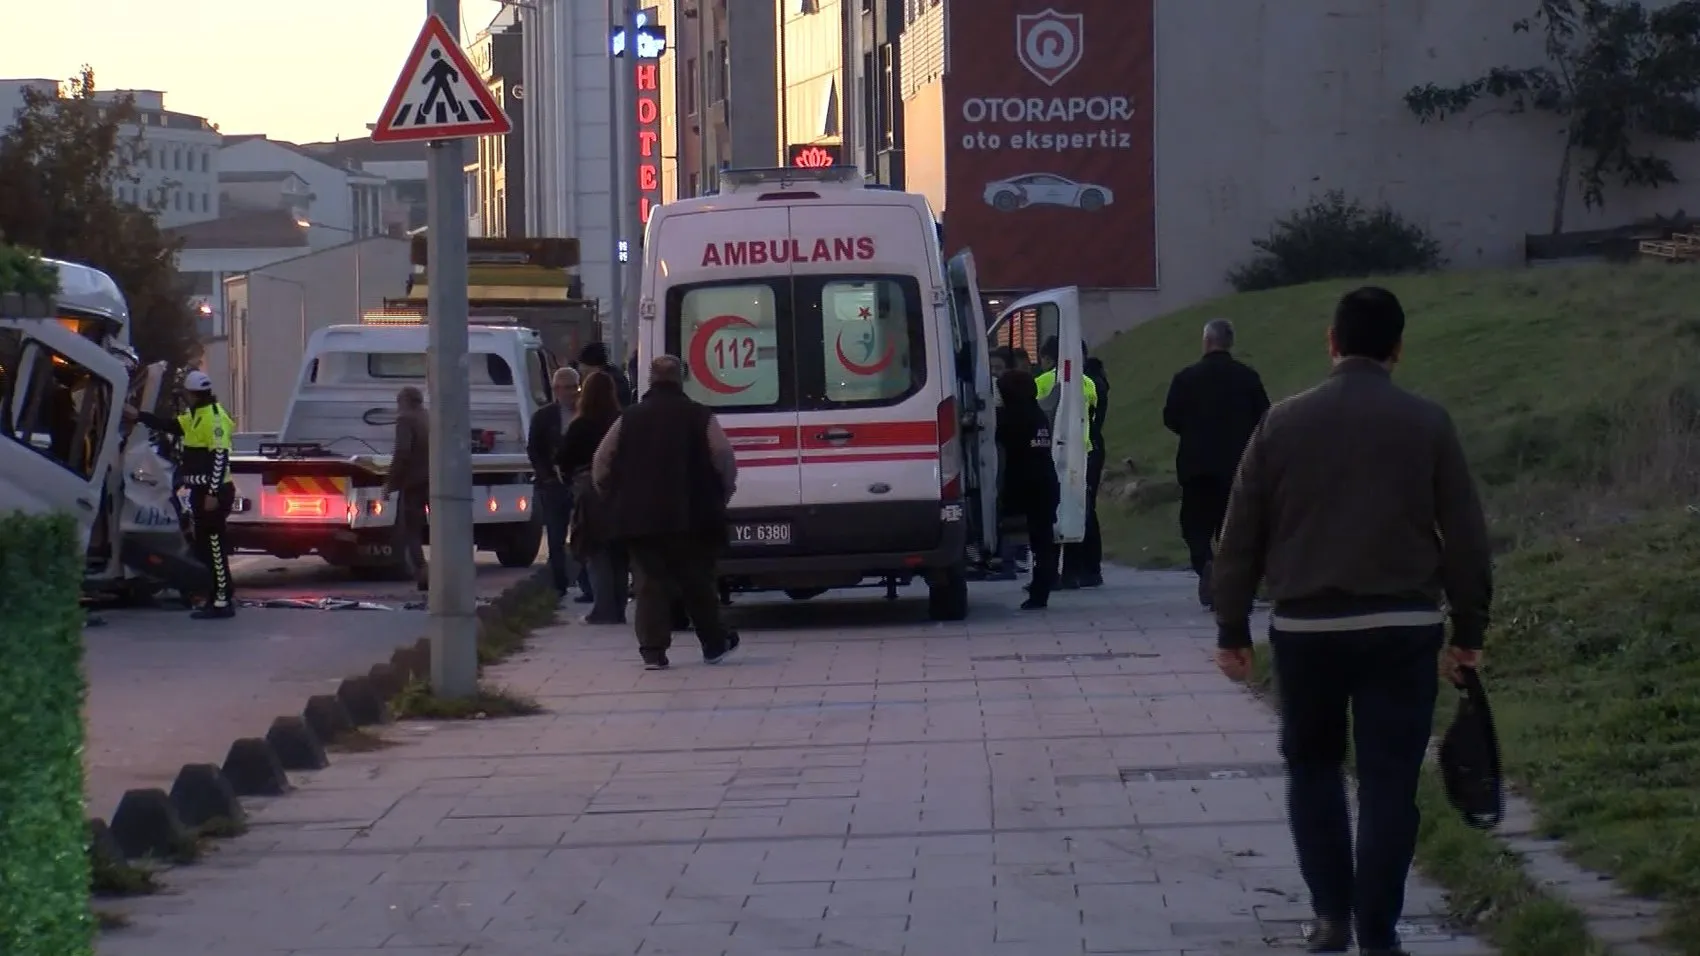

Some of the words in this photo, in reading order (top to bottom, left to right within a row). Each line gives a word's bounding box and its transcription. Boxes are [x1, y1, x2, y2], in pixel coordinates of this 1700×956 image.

[962, 97, 1135, 122] OTORAPOR
[962, 131, 1001, 149] oto
[1010, 129, 1131, 152] ekspertiz
[701, 236, 876, 267] AMBULANS
[714, 336, 757, 369] 112
[735, 525, 751, 540] YC
[757, 524, 788, 540] 6380
